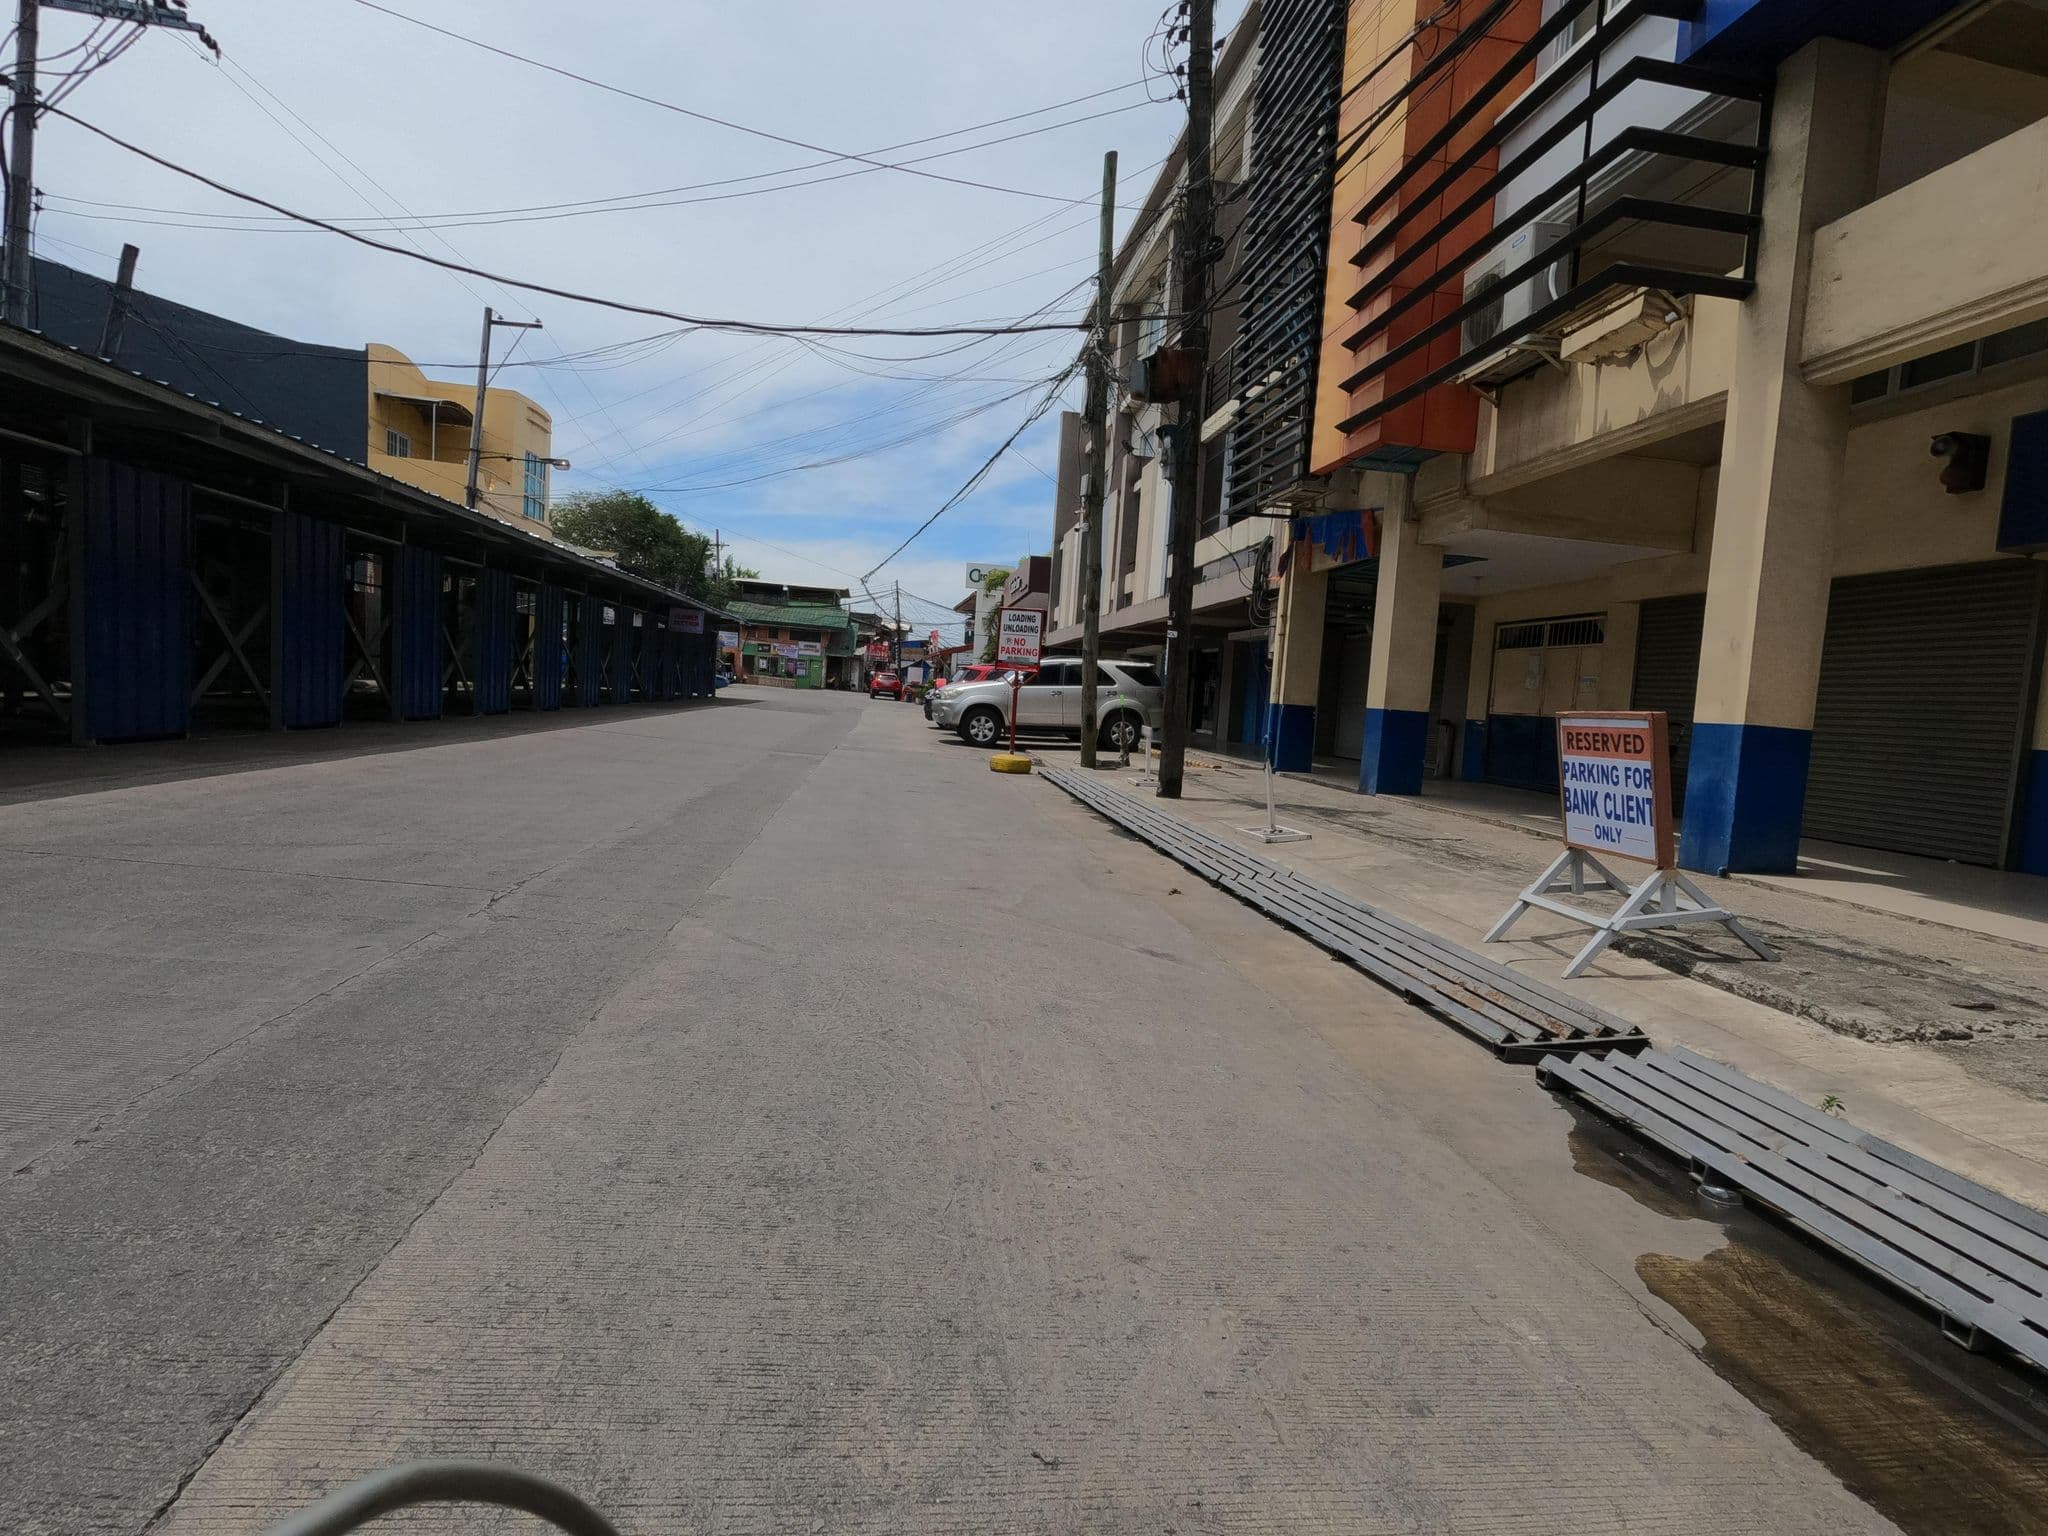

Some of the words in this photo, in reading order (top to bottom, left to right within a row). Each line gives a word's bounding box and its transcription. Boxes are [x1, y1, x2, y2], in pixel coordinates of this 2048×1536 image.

[1009, 614, 1036, 623] LOADING
[1003, 624, 1038, 633] UNLOADING
[1013, 638, 1025, 646] NO
[1001, 647, 1037, 656] PARKING
[1567, 732, 1644, 754] RESERVED
[1563, 761, 1619, 786] PARKING
[1625, 766, 1652, 790] FOR
[1565, 787, 1600, 817] BANK
[1594, 824, 1622, 844] ONLY
